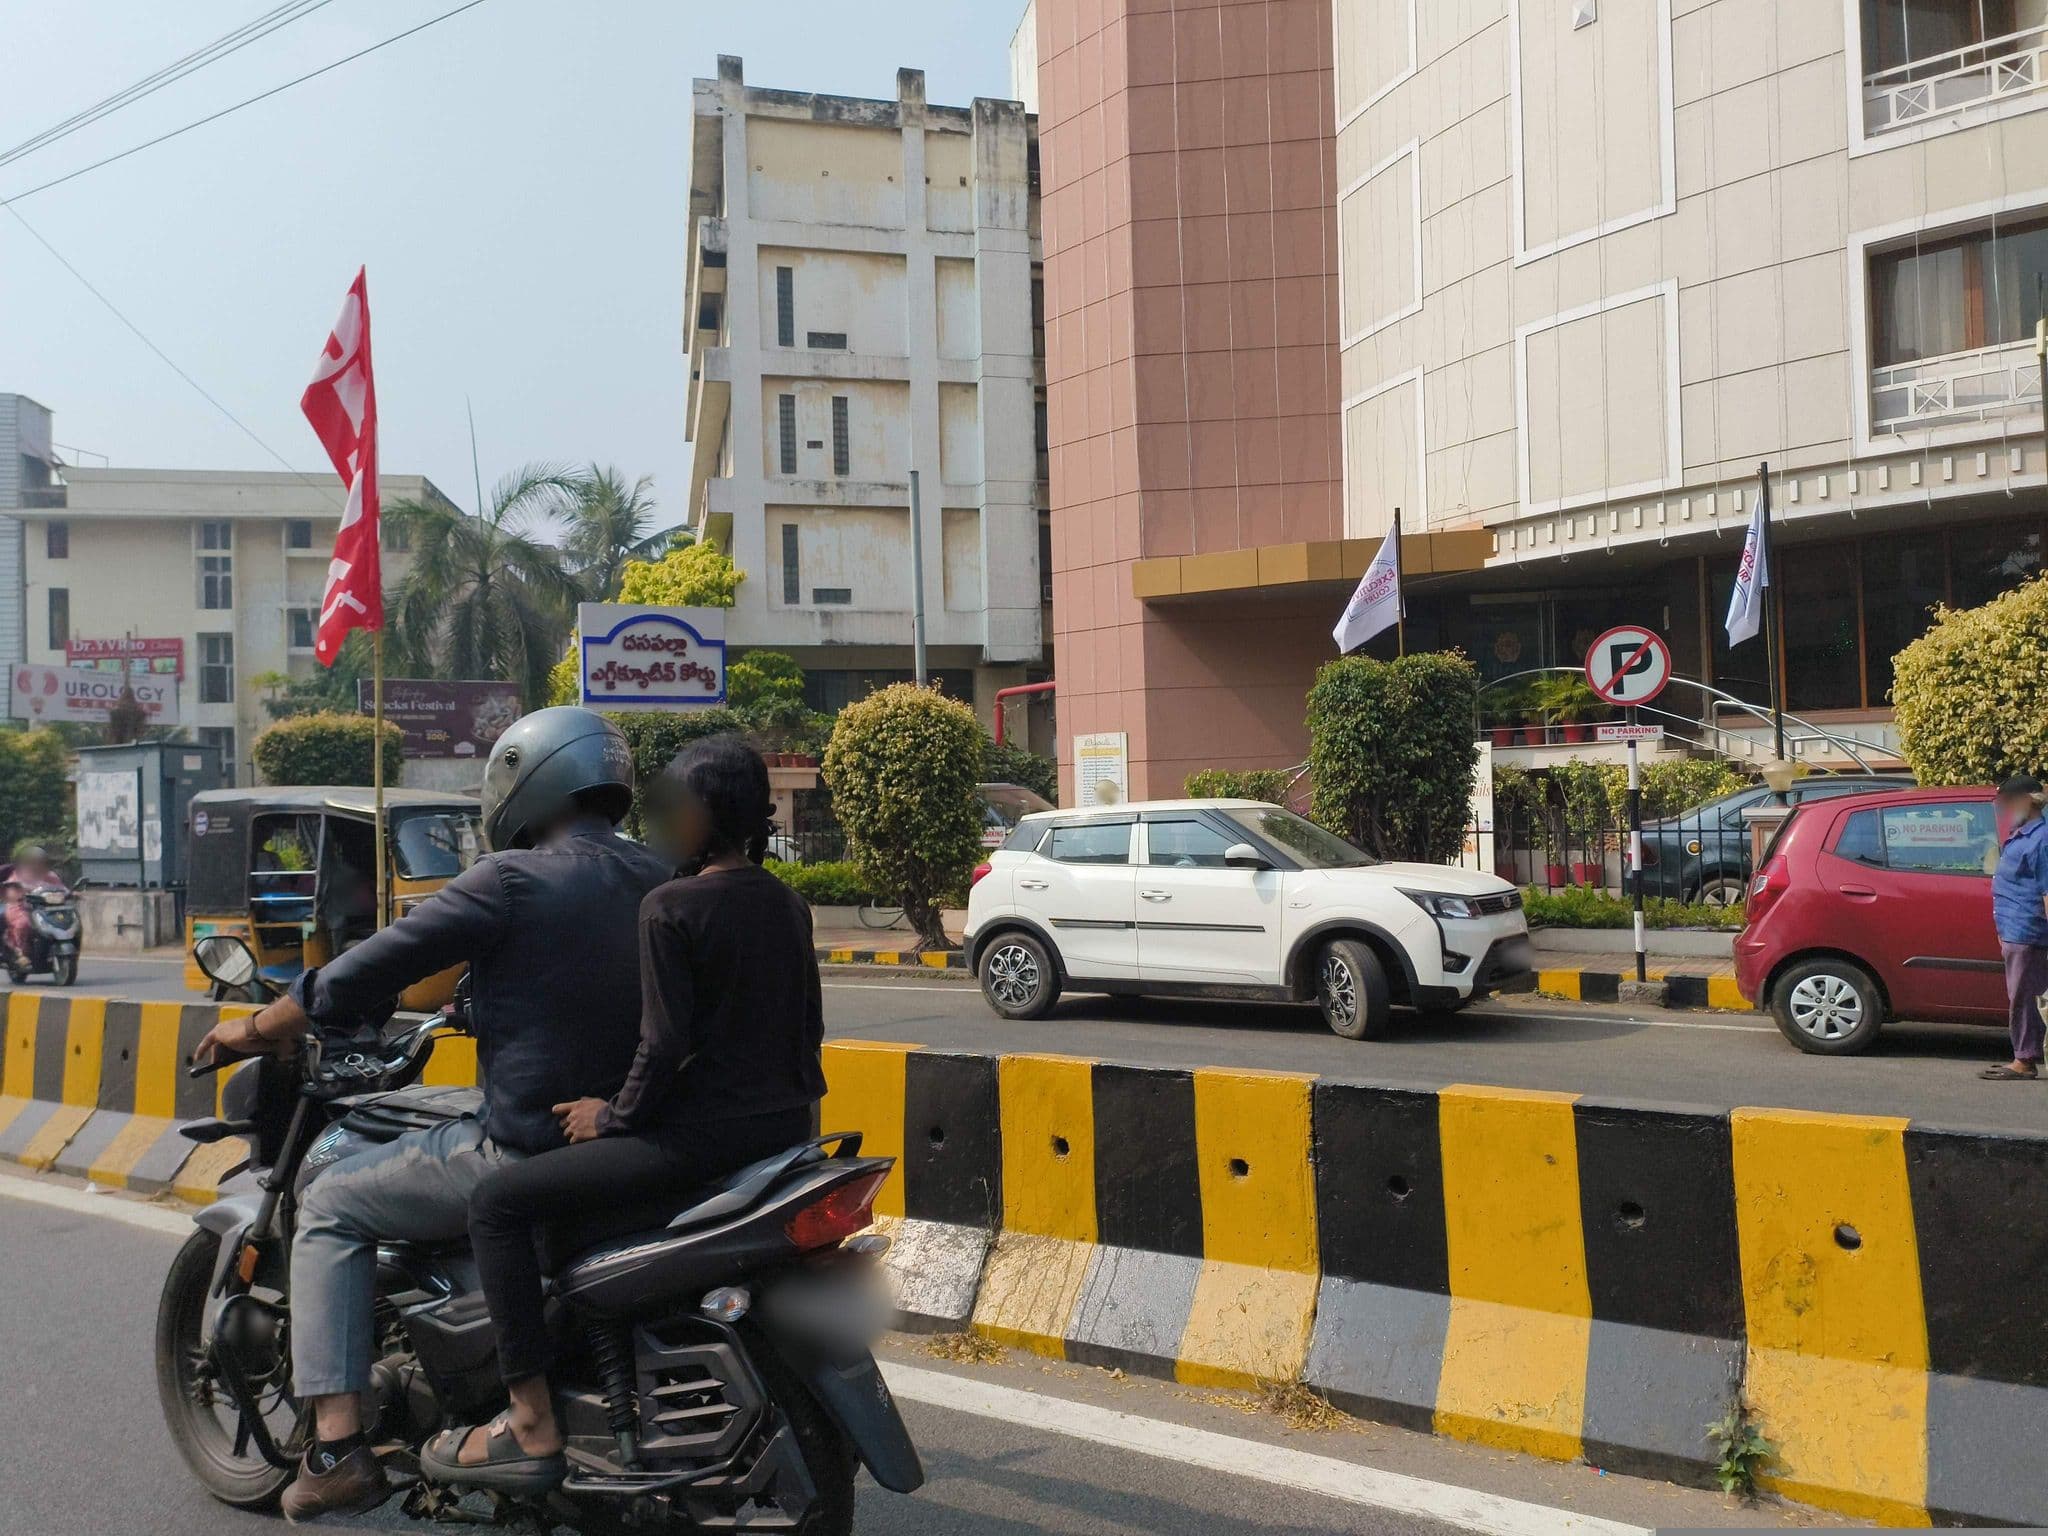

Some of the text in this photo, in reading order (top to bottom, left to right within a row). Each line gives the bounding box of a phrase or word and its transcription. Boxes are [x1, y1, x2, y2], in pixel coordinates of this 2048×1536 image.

[410, 700, 456, 711] Festival
[1601, 726, 1659, 735] NO PARKING
[1902, 824, 1917, 833] NO
[1919, 823, 1964, 833] PARKING
